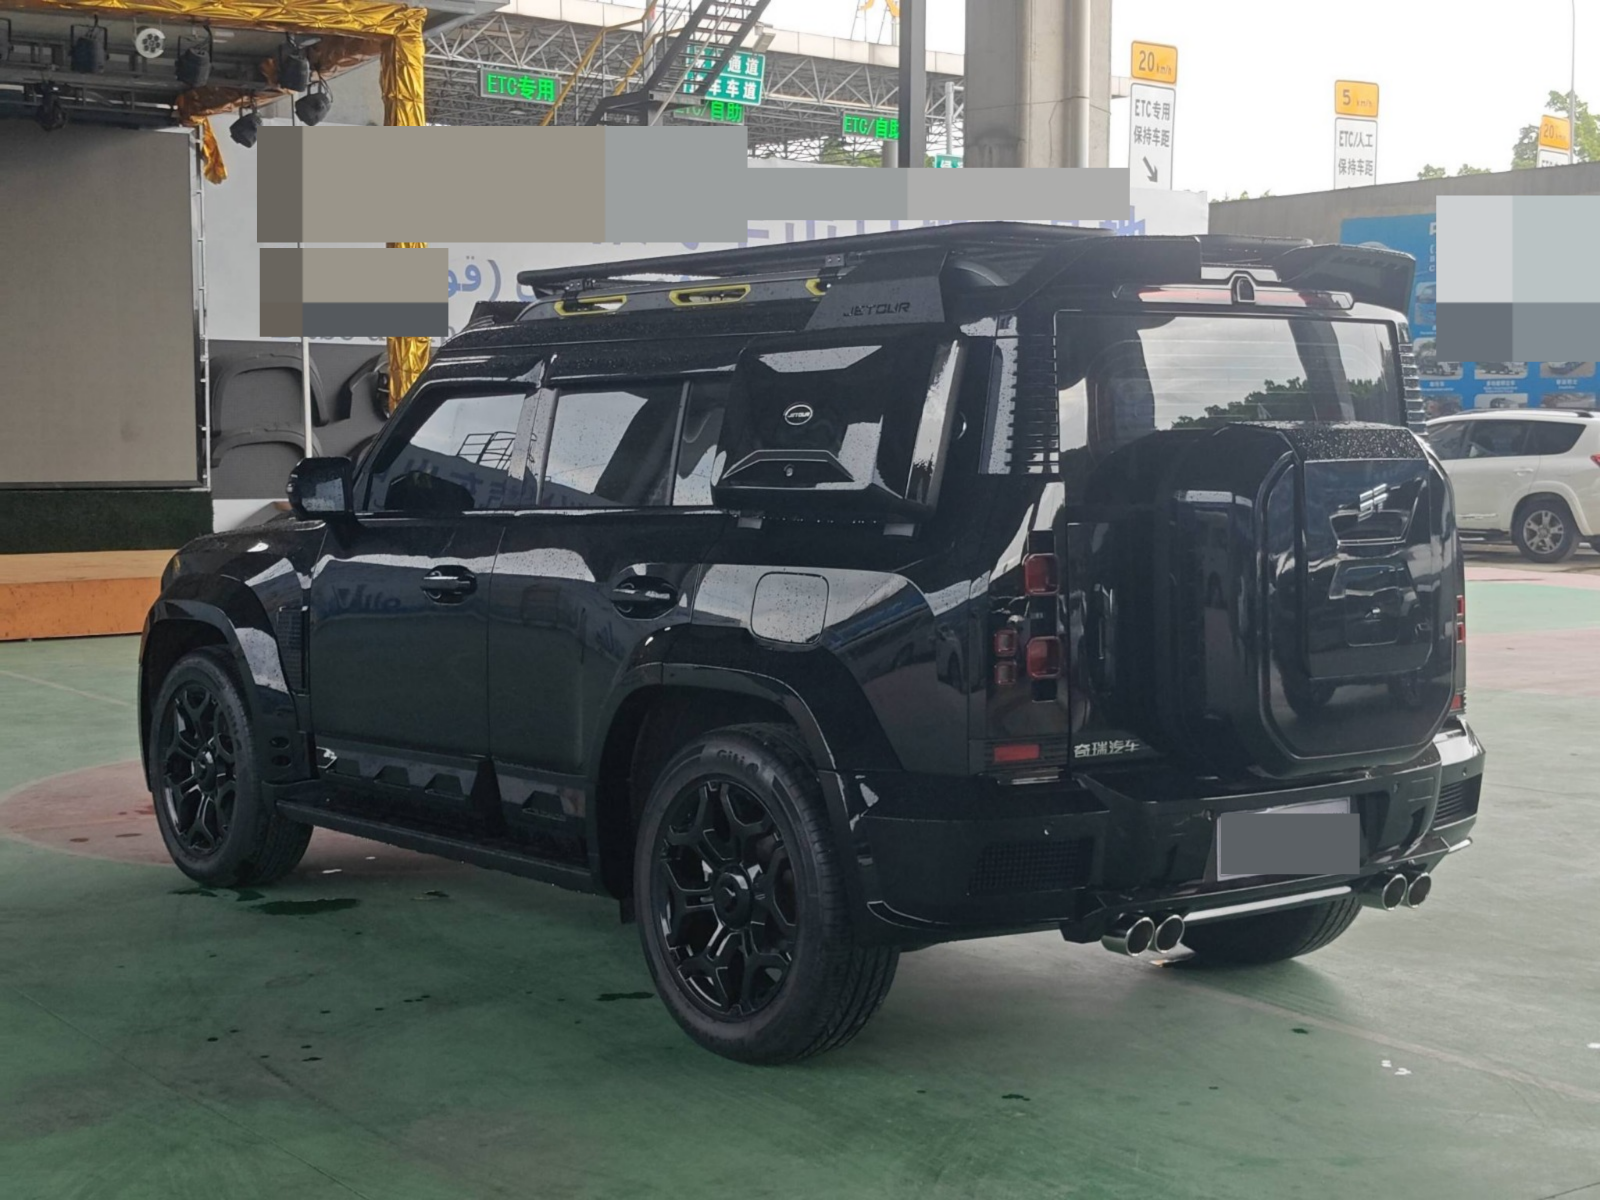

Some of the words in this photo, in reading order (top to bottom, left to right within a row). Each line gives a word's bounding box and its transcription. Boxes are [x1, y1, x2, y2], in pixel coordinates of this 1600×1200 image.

[1139, 50, 1155, 72] 20
[1157, 62, 1172, 76] km/h
[487, 73, 554, 102] ETC专用
[1342, 88, 1351, 106] 5
[1134, 98, 1170, 121] ETC专用
[1133, 124, 1170, 148] 保持车距
[1338, 130, 1373, 148] ETC/人工
[1543, 123, 1555, 139] 20
[1338, 158, 1374, 177] 保持车距
[843, 302, 911, 317] JETOUR
[1073, 739, 1140, 758] 奇瑞汽车
